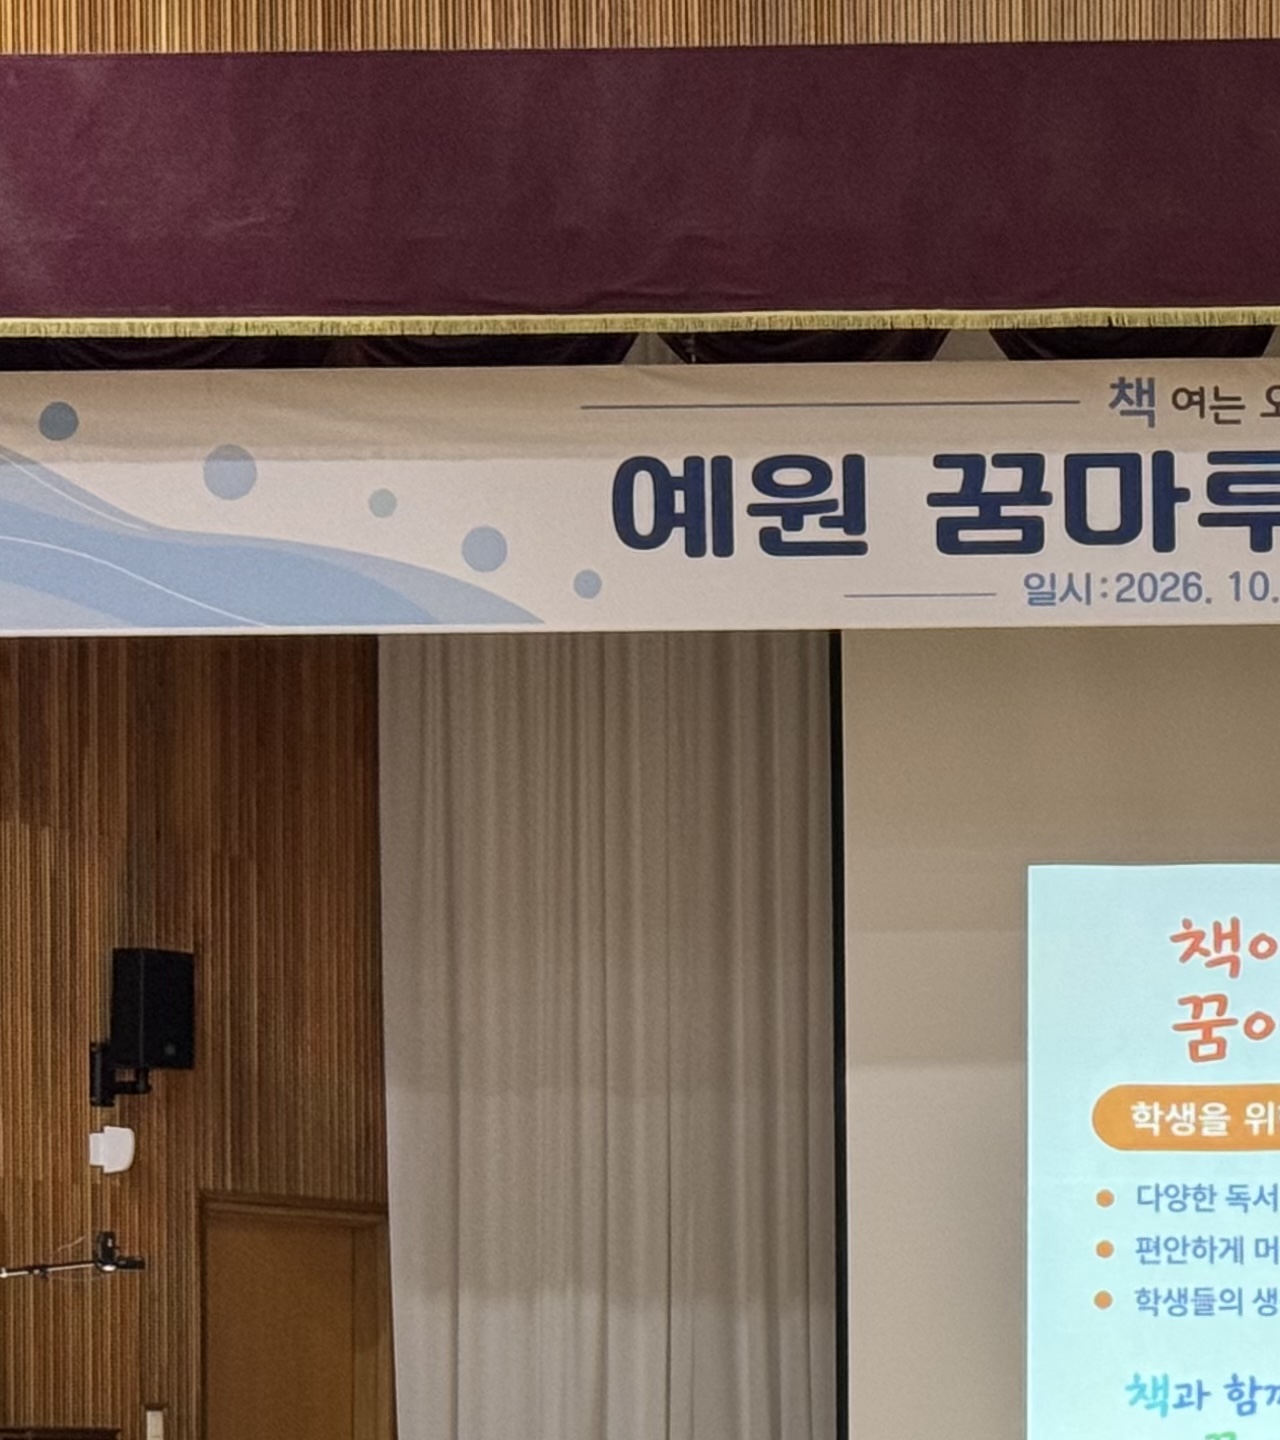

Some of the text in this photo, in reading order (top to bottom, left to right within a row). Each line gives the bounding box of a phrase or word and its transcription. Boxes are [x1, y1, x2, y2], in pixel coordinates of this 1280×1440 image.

[1109, 377, 1155, 428] 책
[1172, 386, 1245, 424] 여는
[612, 454, 868, 558] 예원
[1229, 571, 1279, 603] 10.
[1131, 1102, 1230, 1136] 학생을
[1137, 1183, 1217, 1212] 다양한
[1136, 1235, 1244, 1265] 편안하게
[1135, 1287, 1243, 1317] 학생들의
[1126, 1374, 1211, 1417] 책과
